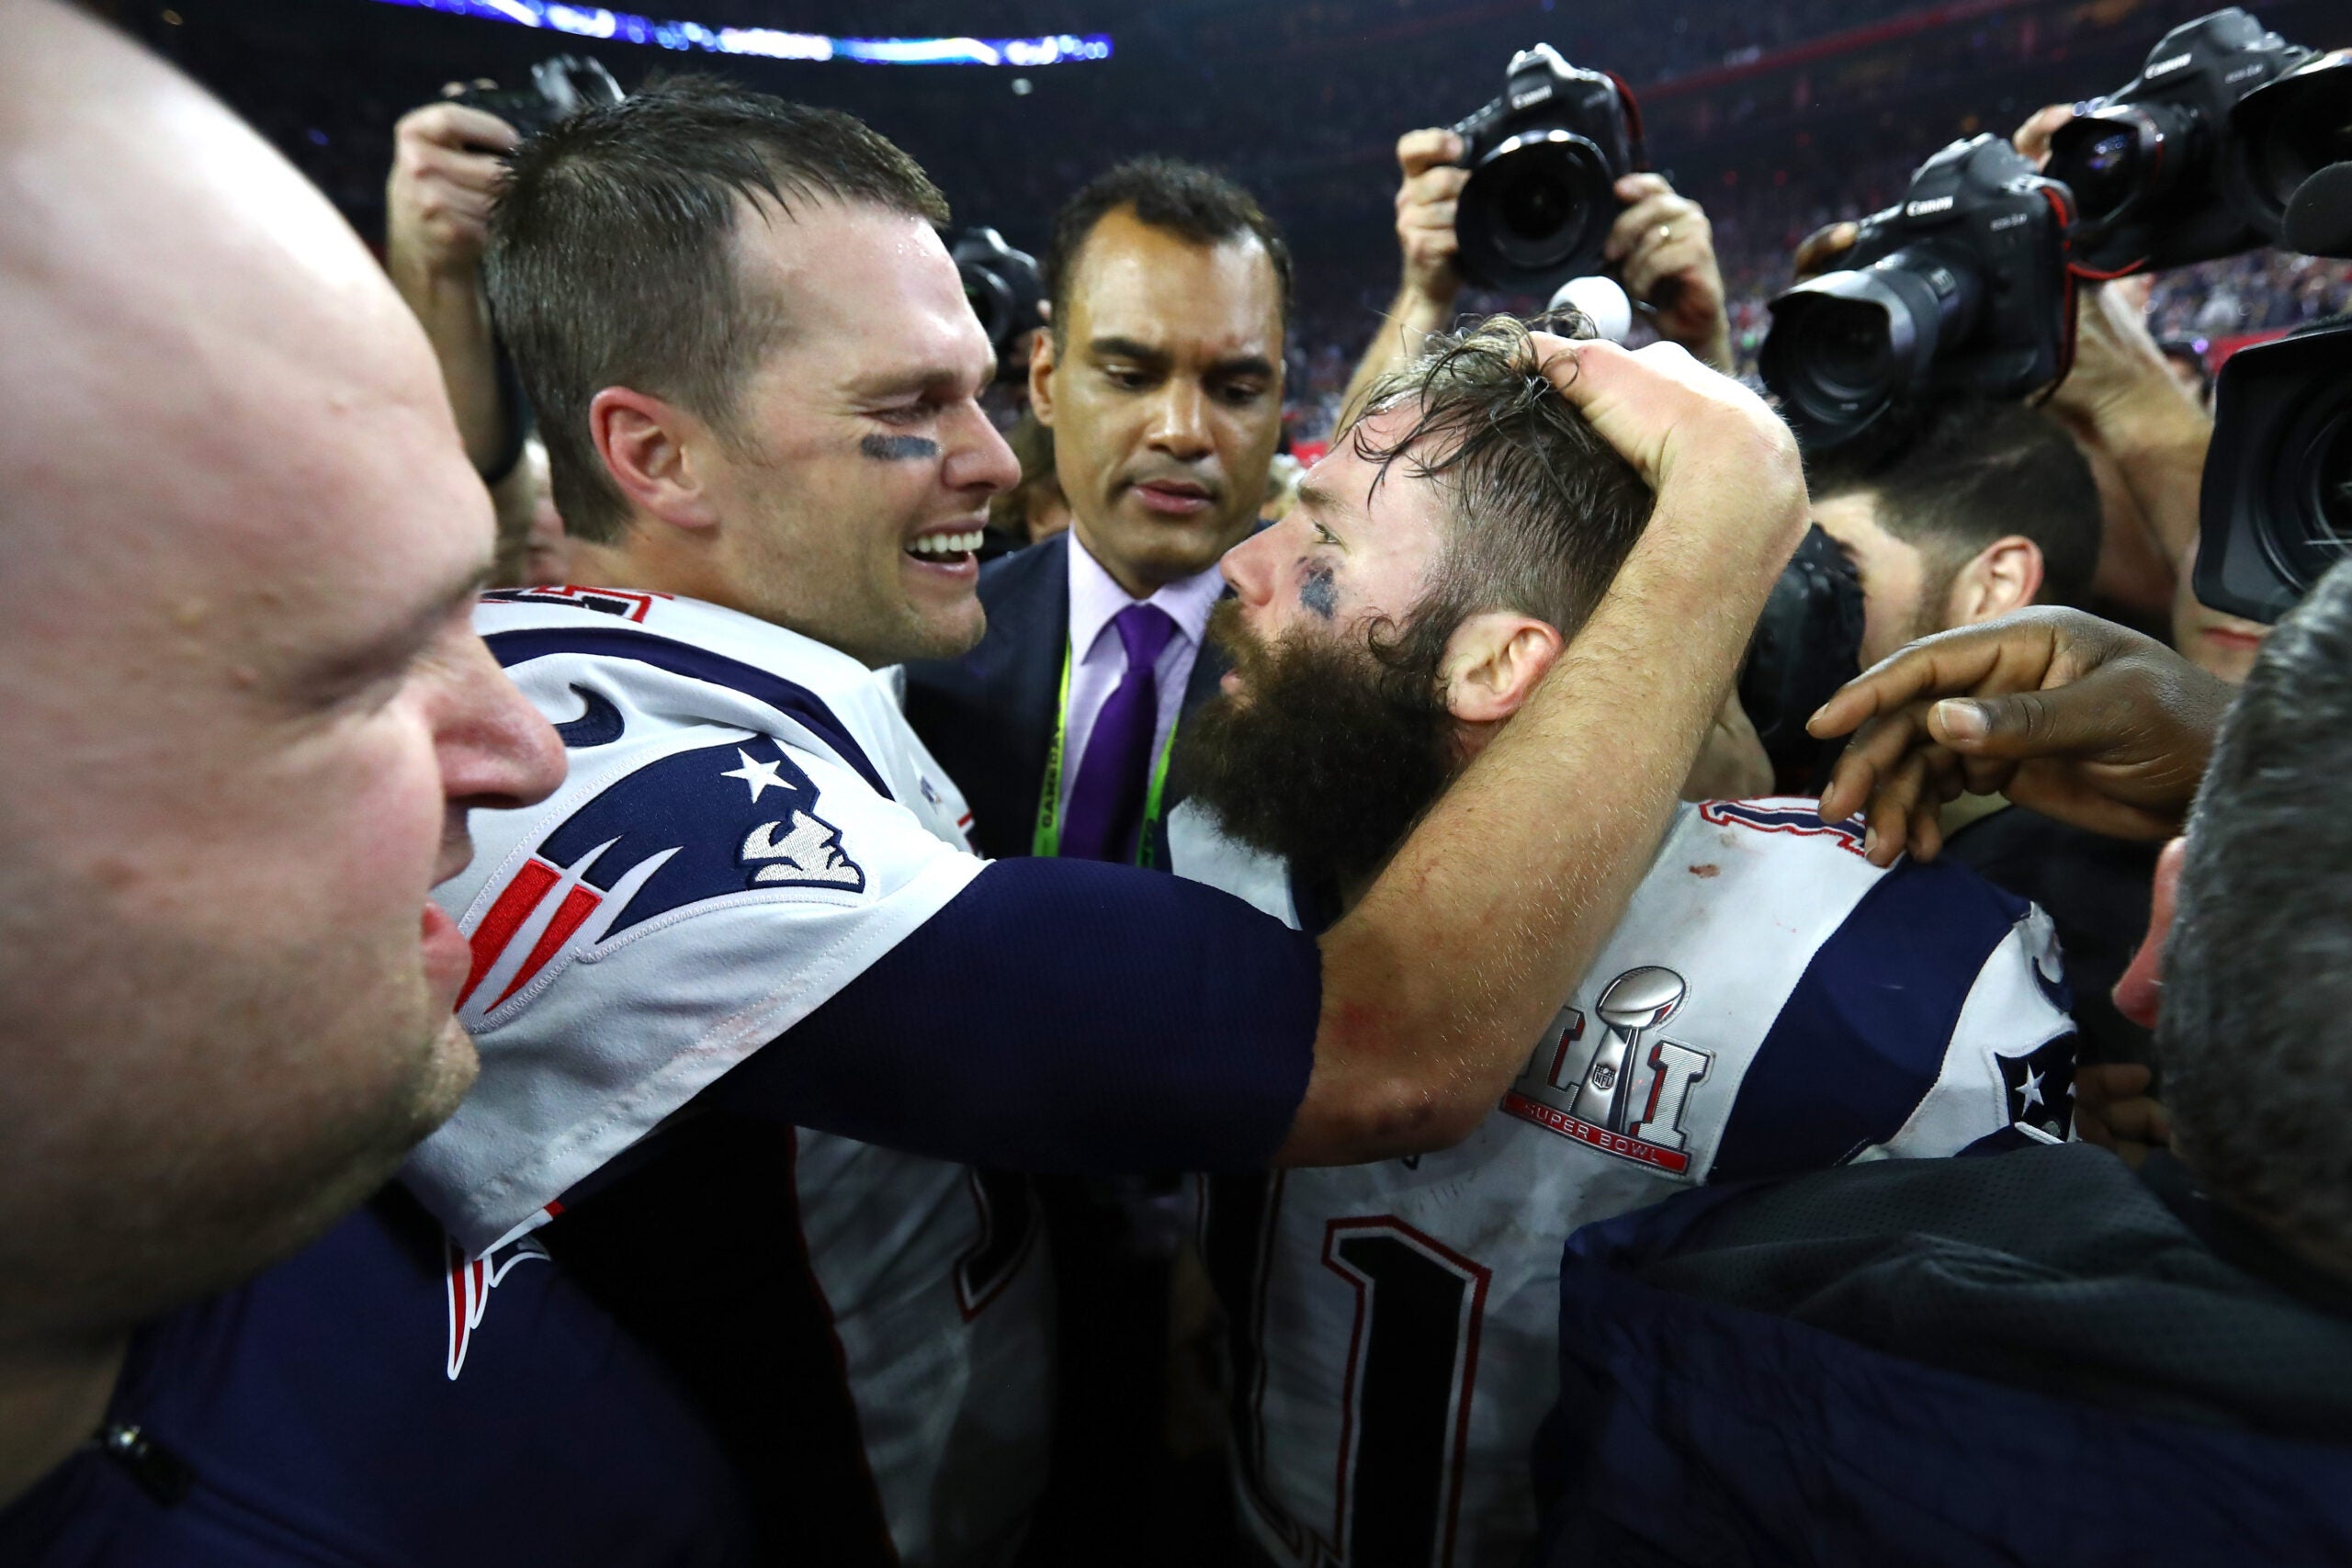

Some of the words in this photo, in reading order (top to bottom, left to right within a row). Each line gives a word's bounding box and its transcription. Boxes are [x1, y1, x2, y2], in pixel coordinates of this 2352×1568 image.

[2144, 52, 2192, 79] Canon
[1906, 196, 1953, 217] Canon
[1594, 1072, 1614, 1089] NFL
[1524, 1102, 1590, 1139] SUPER
[1599, 1134, 1660, 1164] BOWL
